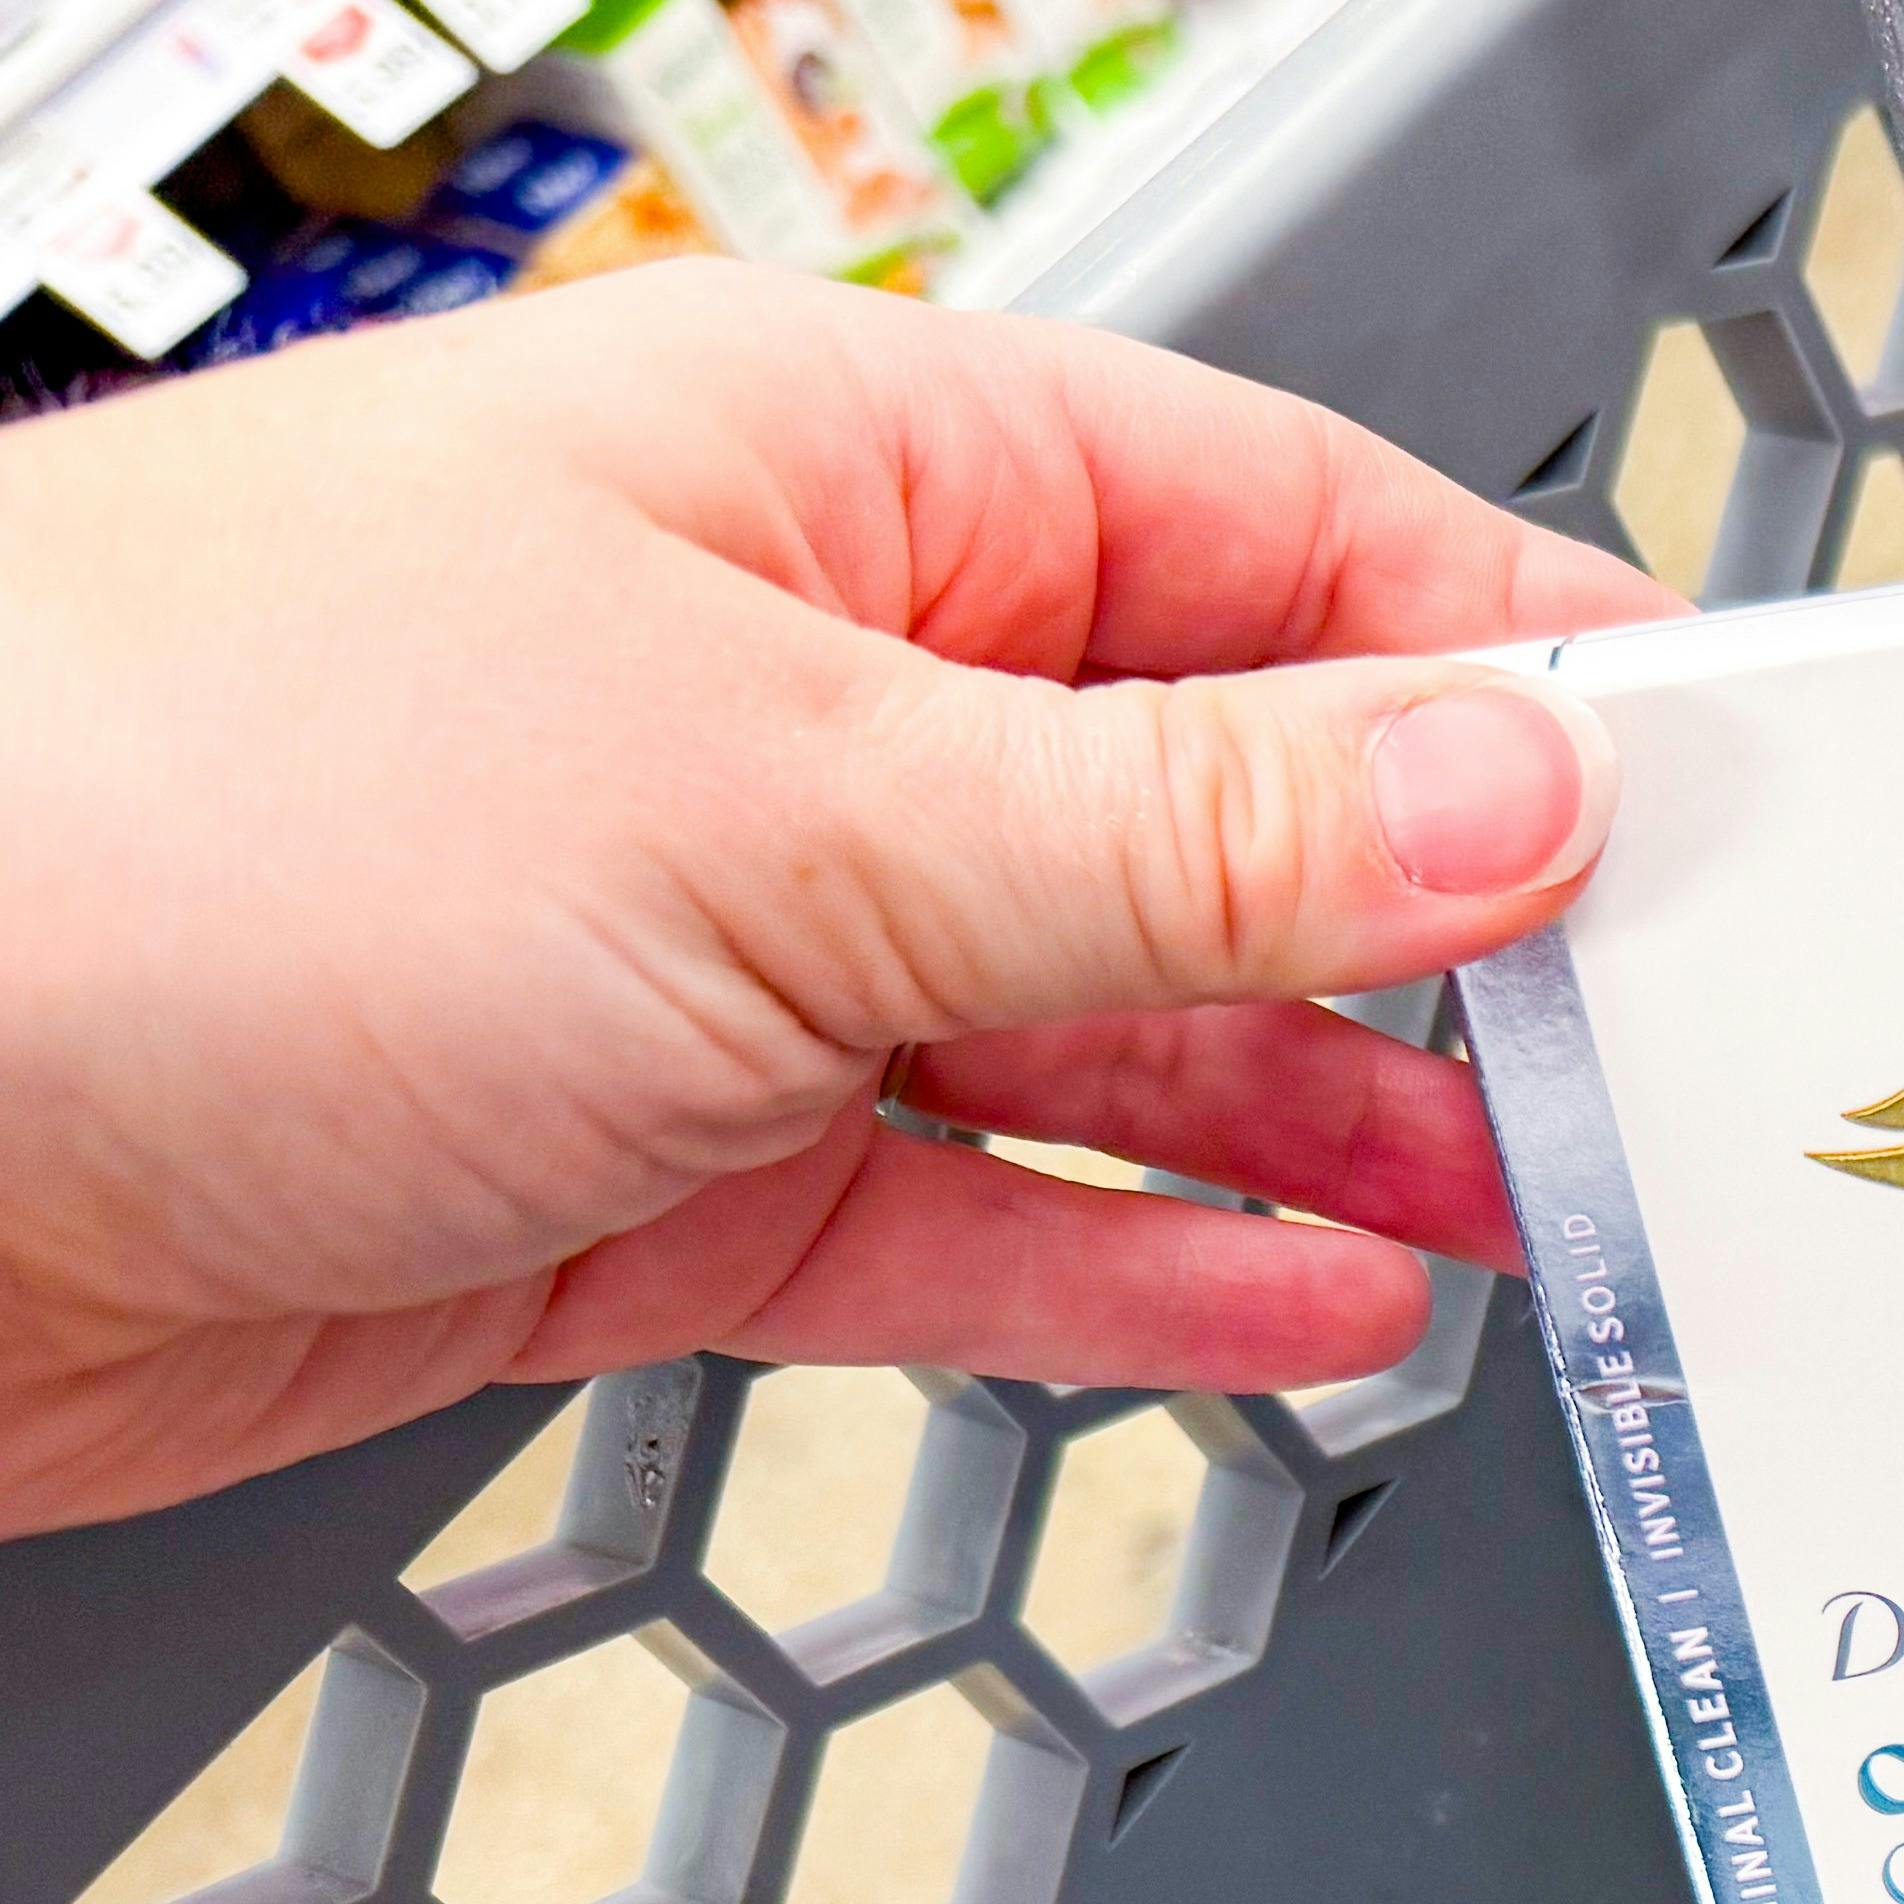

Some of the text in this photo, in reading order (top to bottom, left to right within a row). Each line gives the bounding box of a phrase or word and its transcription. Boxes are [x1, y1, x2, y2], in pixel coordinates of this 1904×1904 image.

[1563, 1212, 1625, 1343] SOLID
[1598, 1348, 1684, 1562] INVISIBLE
[1676, 1625, 1746, 1774] CLEAN
